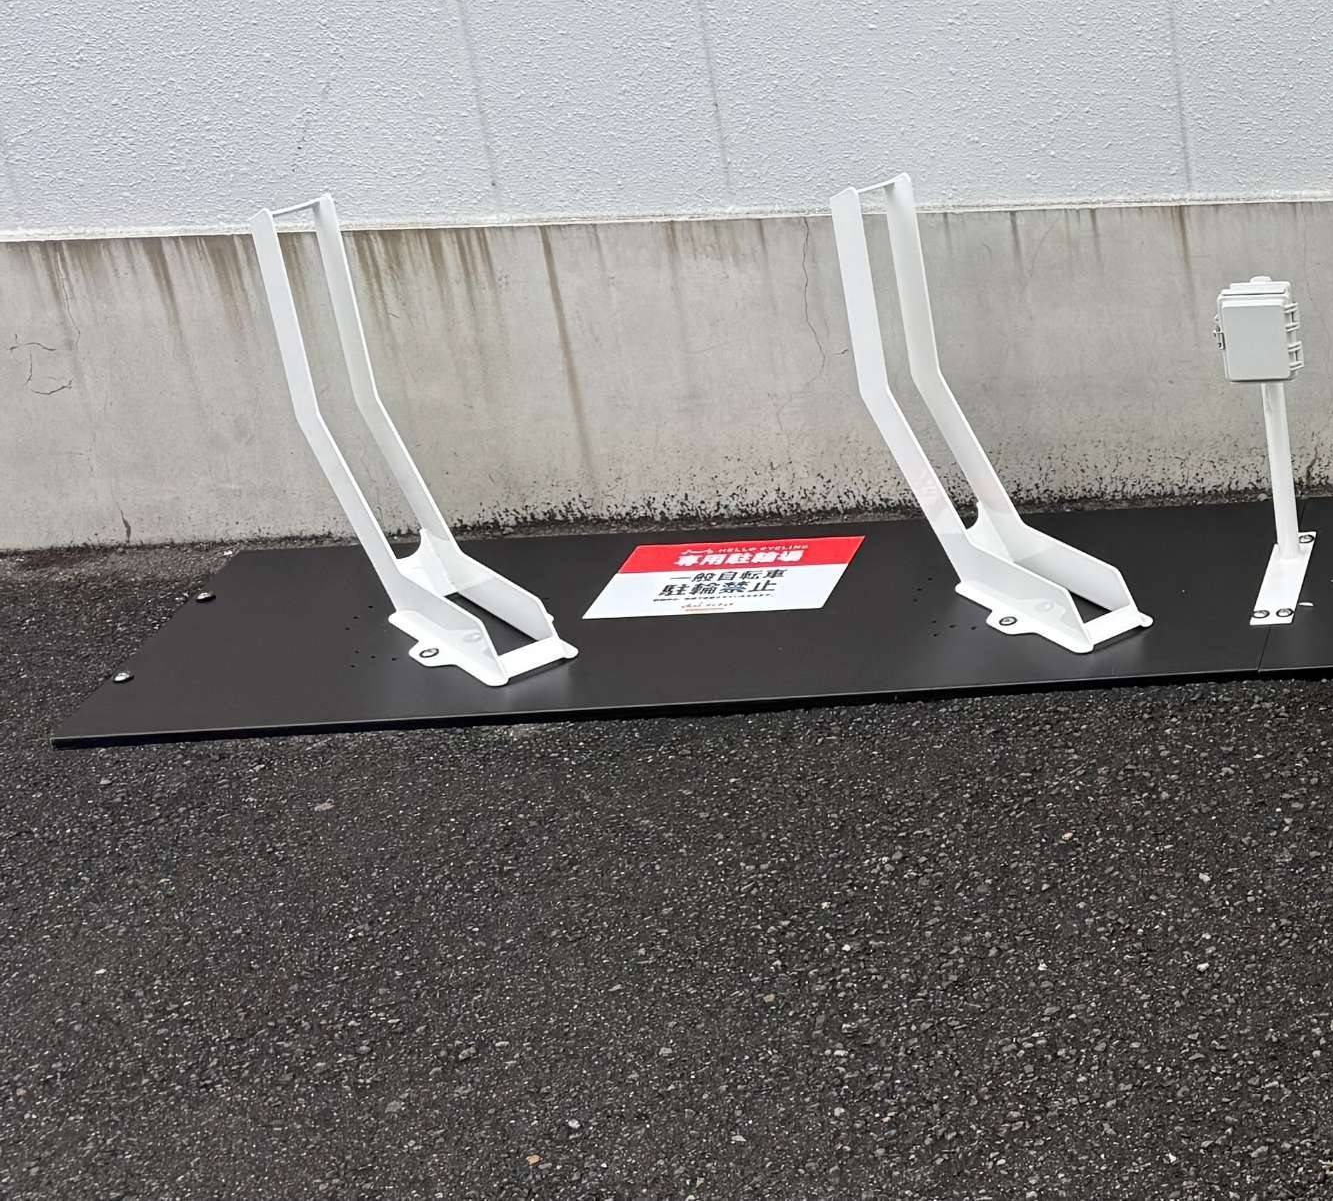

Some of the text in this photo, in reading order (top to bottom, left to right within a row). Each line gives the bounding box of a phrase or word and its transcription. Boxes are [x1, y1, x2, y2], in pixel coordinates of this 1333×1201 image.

[675, 550, 804, 567] 専用駐輪場
[670, 569, 788, 583] 一般自転車
[658, 580, 777, 596] 駐輪禁止
